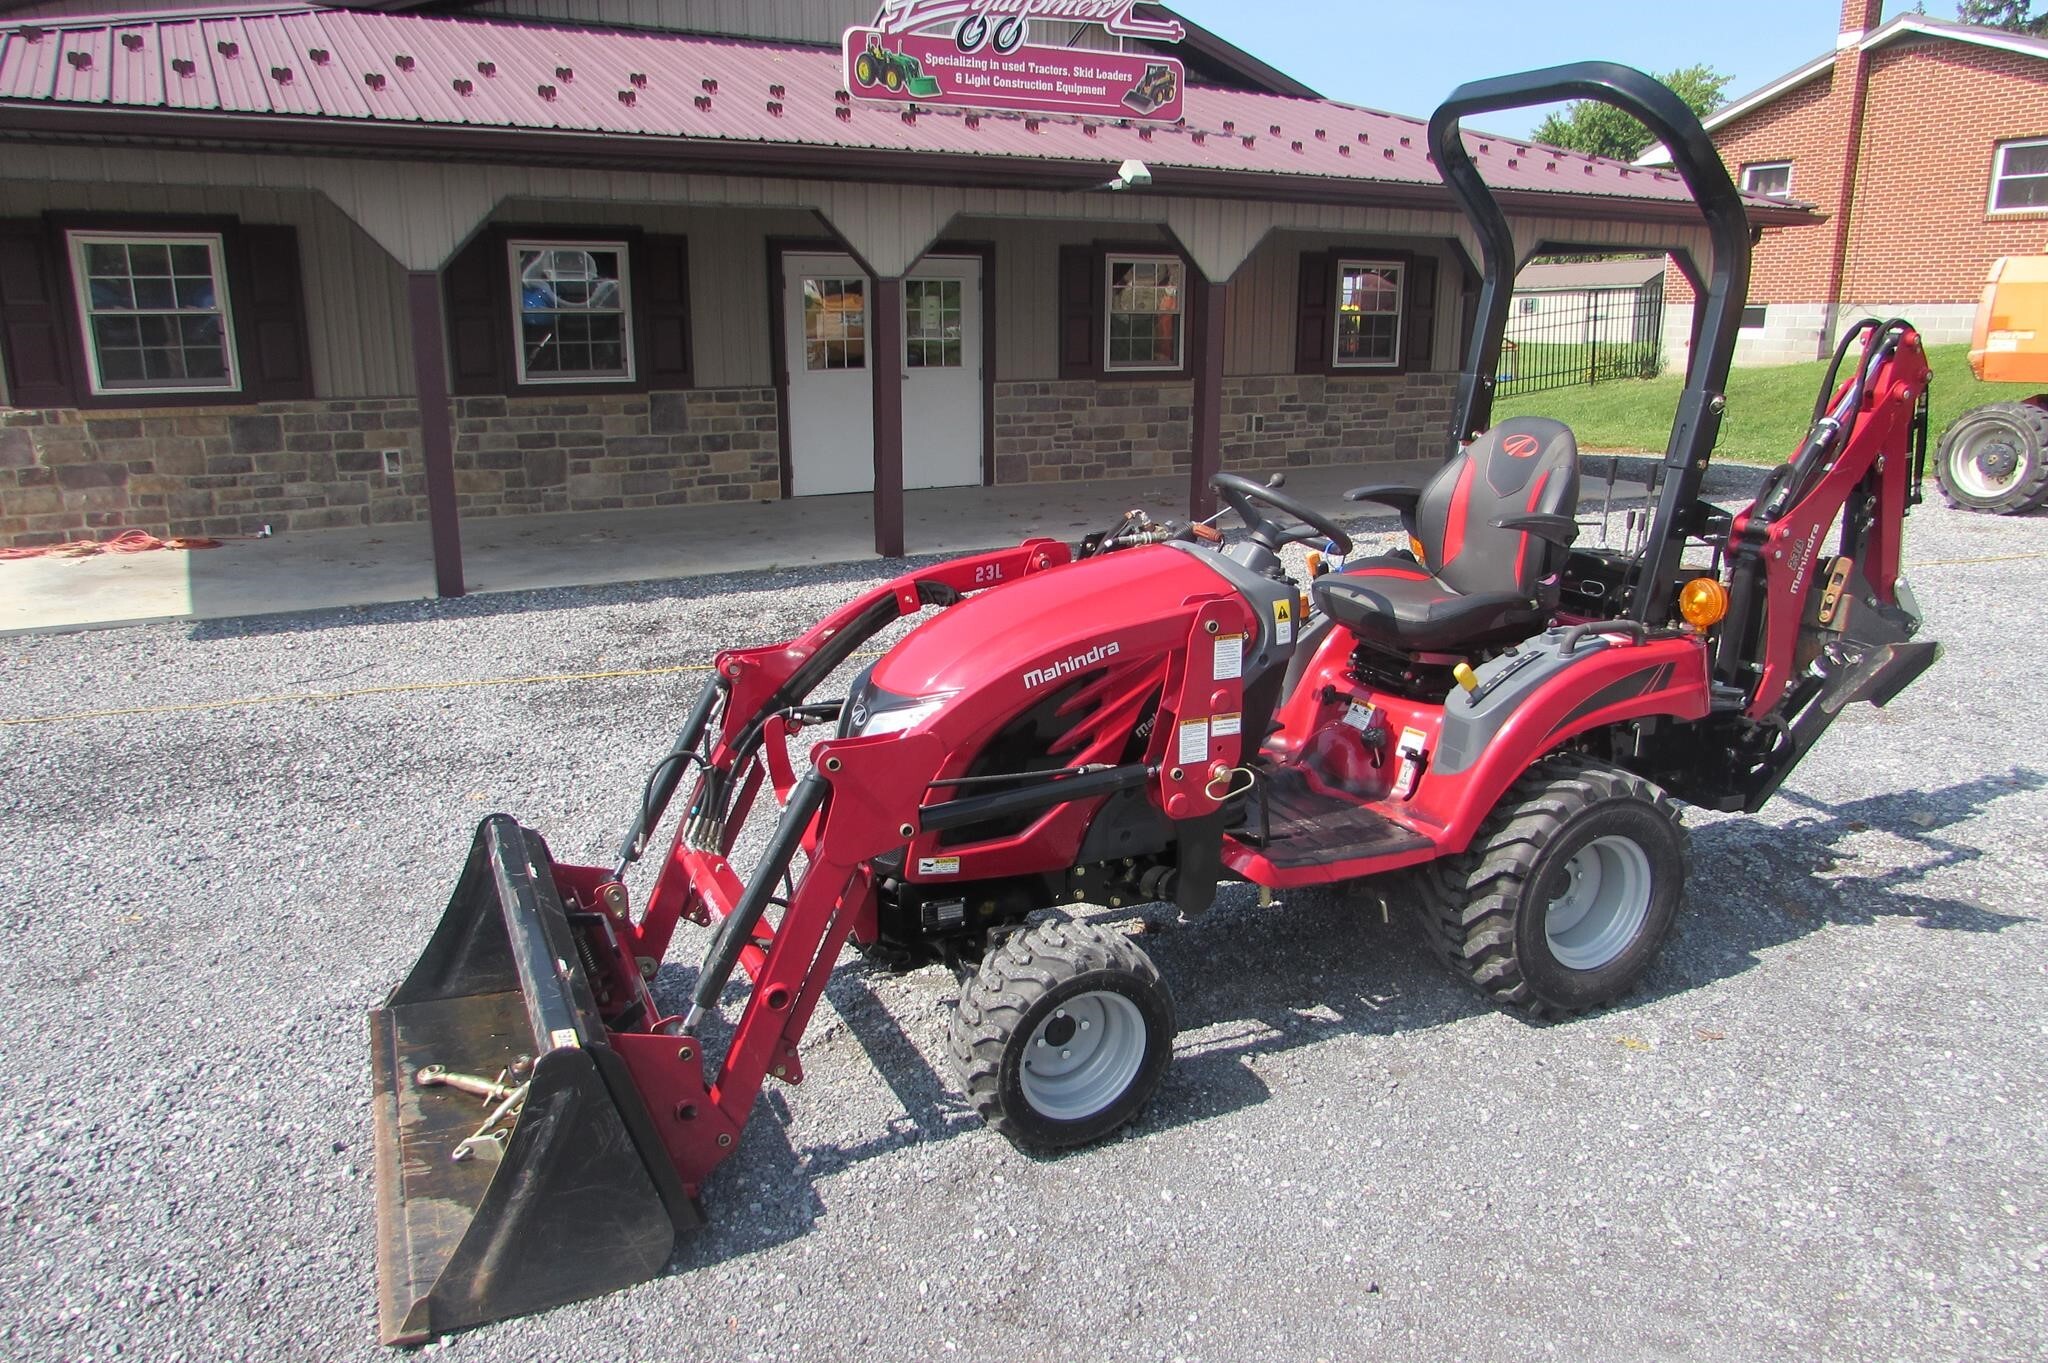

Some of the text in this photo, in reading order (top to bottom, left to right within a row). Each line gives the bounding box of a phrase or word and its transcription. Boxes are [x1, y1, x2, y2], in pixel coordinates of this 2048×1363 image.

[925, 52, 988, 71] Specializing
[990, 59, 999, 70] in
[1002, 61, 1026, 72] used
[1073, 66, 1094, 79] Skid
[1096, 69, 1133, 82] Loaders
[955, 72, 1106, 96] & Light Construction Equipment
[975, 563, 1003, 583] 23L
[1790, 524, 1820, 594] Mahindra
[1023, 641, 1120, 689] Mahindra
